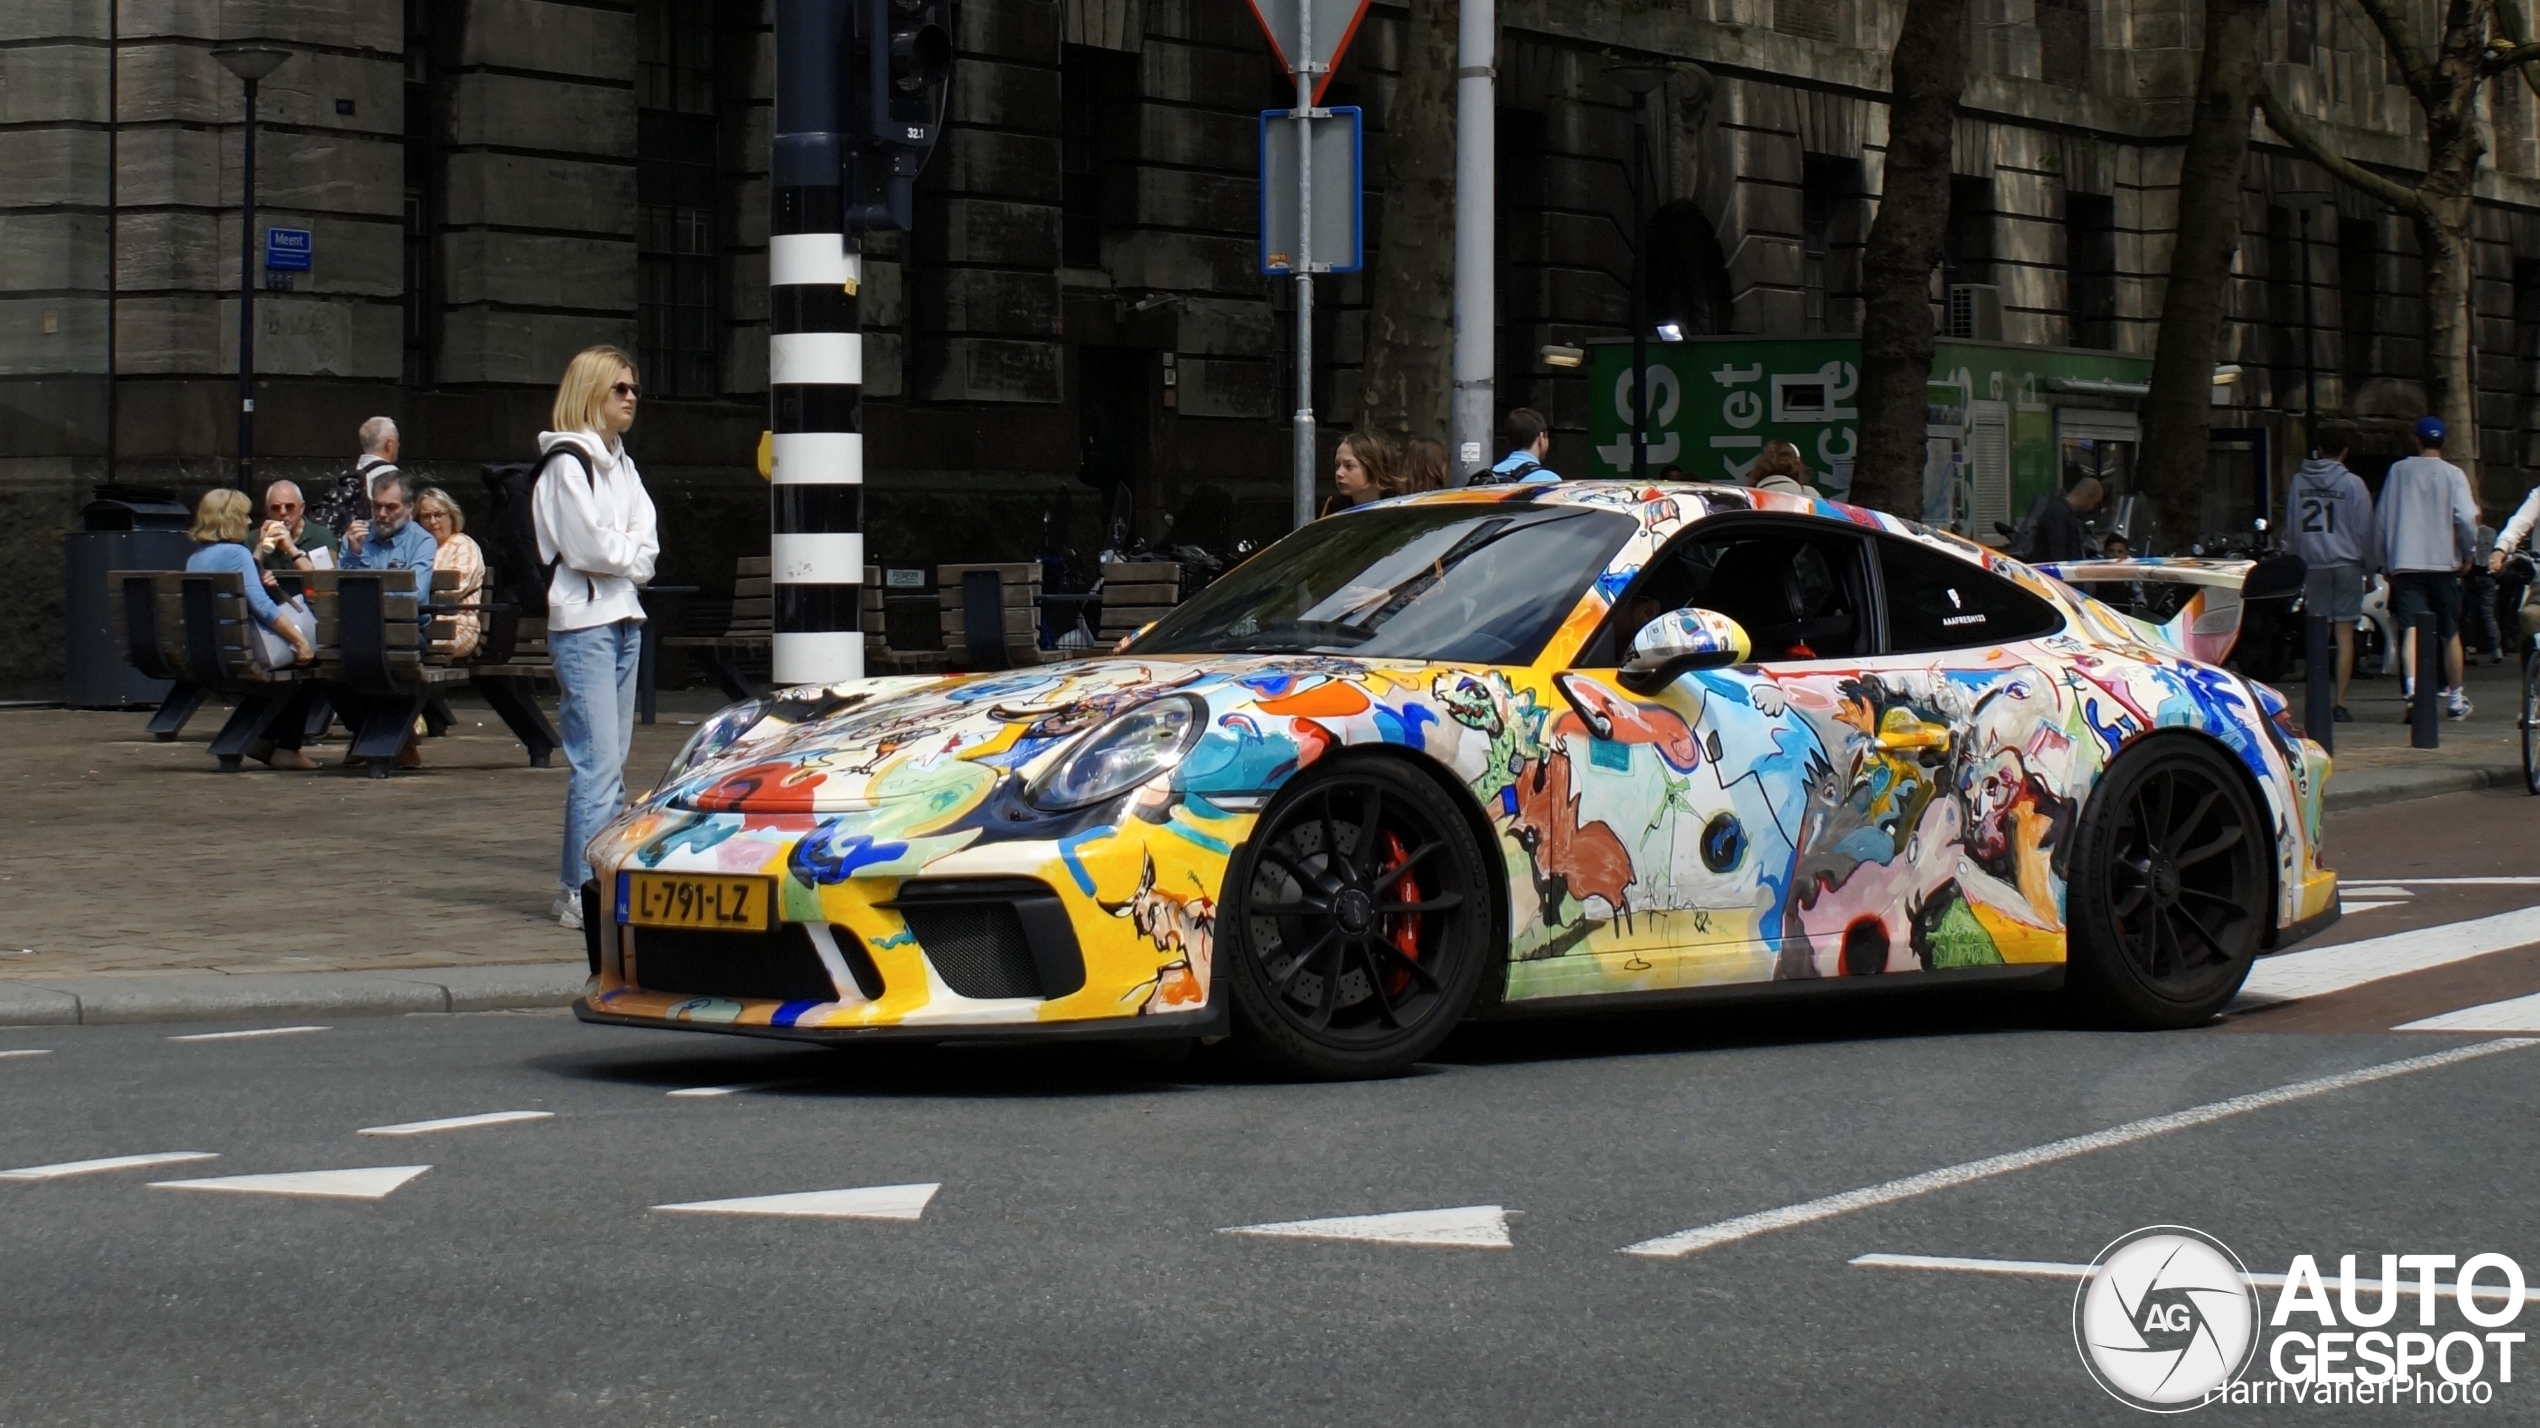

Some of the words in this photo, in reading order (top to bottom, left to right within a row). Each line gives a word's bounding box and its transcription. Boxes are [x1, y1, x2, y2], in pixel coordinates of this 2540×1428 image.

[907, 127, 924, 139] 32.1
[275, 233, 304, 246] Meent
[2302, 499, 2335, 533] 21
[1942, 613, 1987, 626] AAAFRESH123
[641, 881, 749, 921] L-791-LZ
[619, 902, 629, 914] NL
